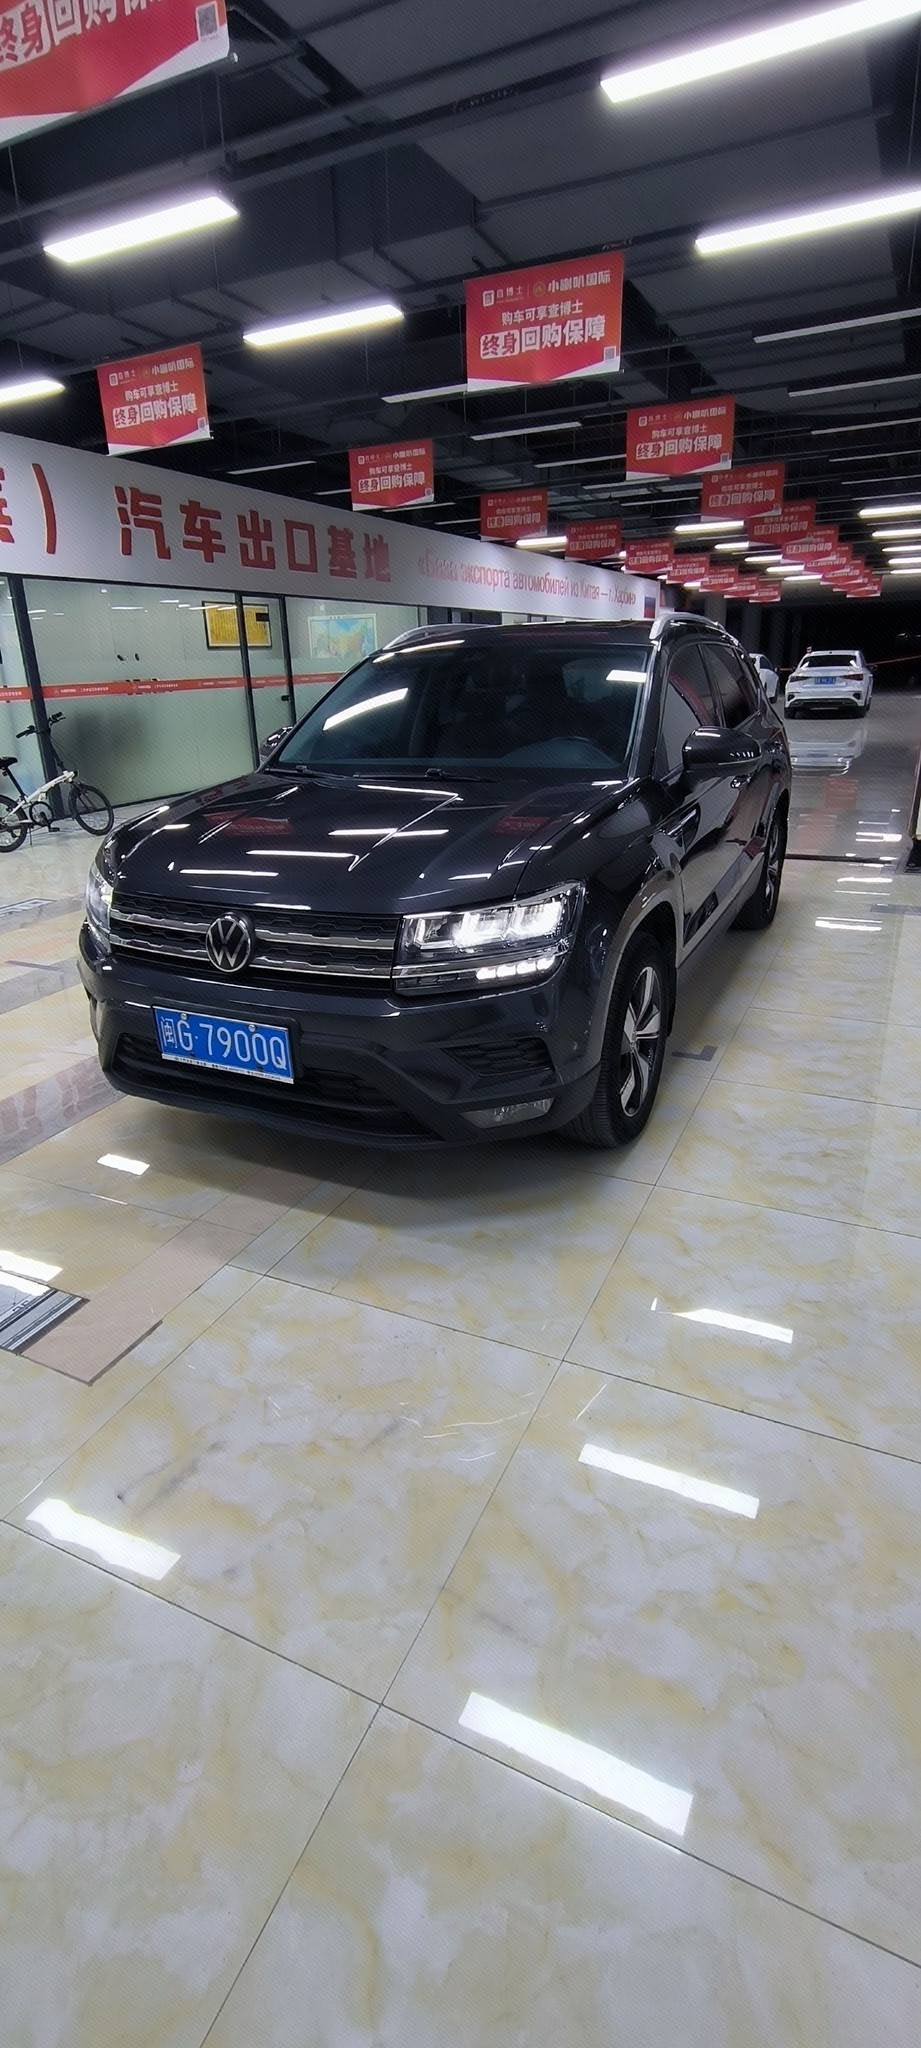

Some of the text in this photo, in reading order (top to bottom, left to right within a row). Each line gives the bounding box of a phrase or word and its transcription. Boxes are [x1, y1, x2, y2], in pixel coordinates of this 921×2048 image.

[501, 299, 583, 326] 购车可享查博士
[481, 315, 606, 357] 终身回购保障
[114, 392, 198, 426] 终身回购保障
[636, 434, 723, 459] 终身回购保障
[359, 471, 425, 493] 终身回购保障
[114, 485, 391, 582] 汽车出口基地
[460, 562, 510, 592] экспорта
[513, 572, 568, 596] автомобилей
[570, 582, 579, 597] из
